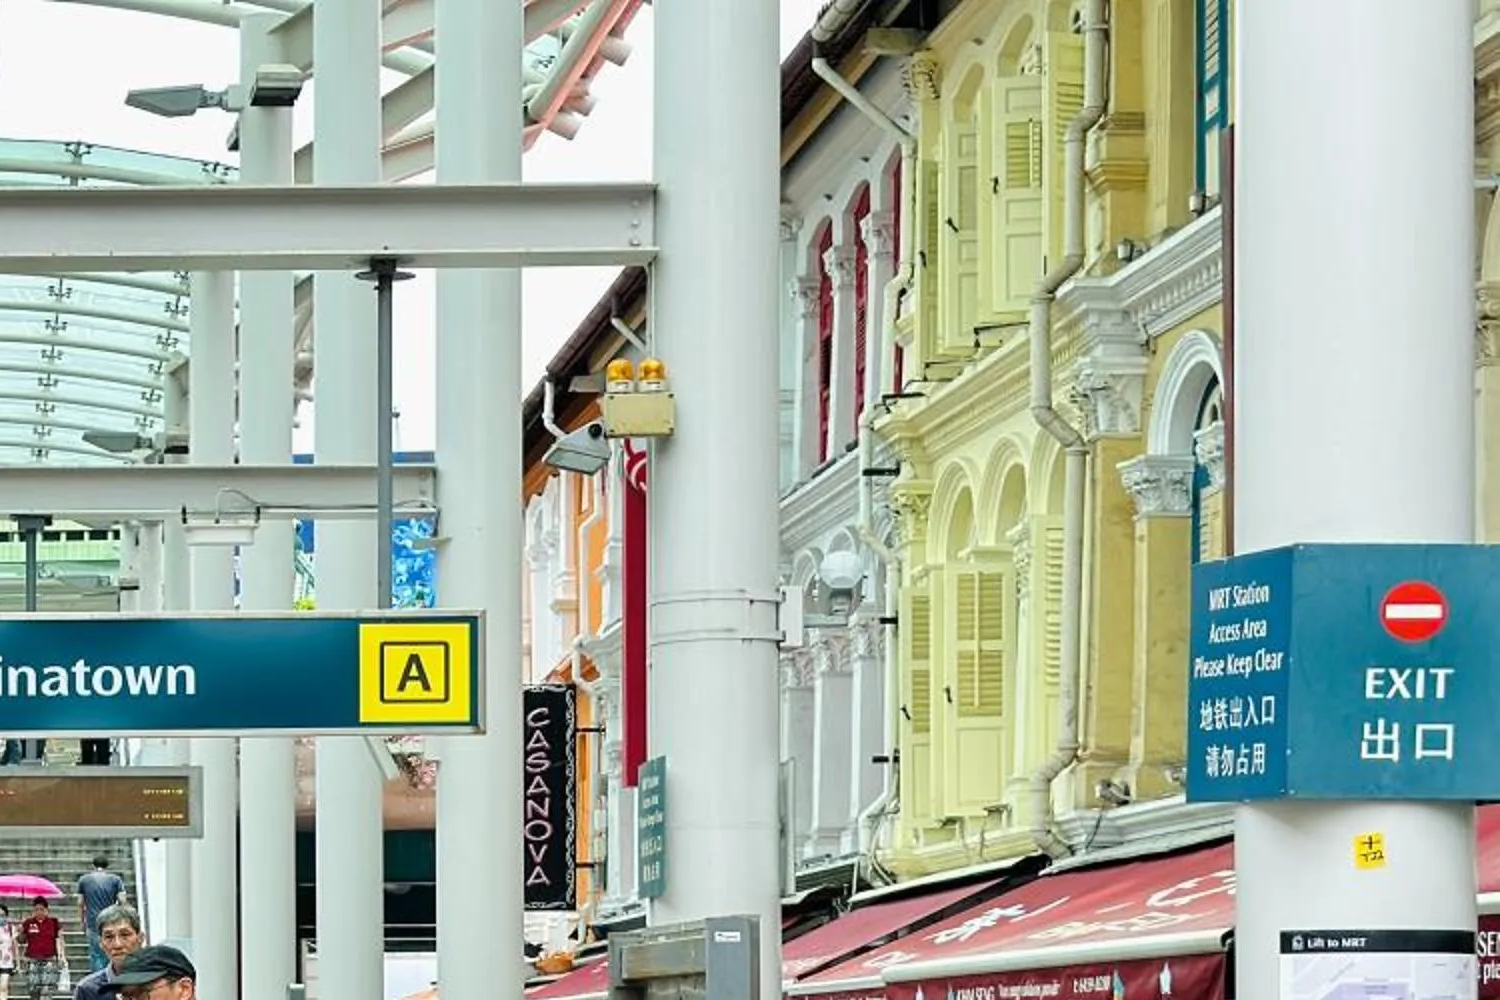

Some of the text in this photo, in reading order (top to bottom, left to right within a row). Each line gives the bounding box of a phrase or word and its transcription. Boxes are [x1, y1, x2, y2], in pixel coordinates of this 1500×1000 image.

[1208, 581, 1270, 612] MRT Station
[1208, 618, 1267, 644] Access Area
[395, 652, 432, 692] A
[1193, 648, 1284, 680] Please Keep Clear
[1364, 667, 1455, 700] EXIT
[1199, 695, 1276, 732] 地铁出入口
[1359, 717, 1456, 763] 出口
[1205, 742, 1267, 779] 请勿占用
[523, 706, 554, 886] CASANOVA
[1307, 936, 1368, 949] Lift to MRT
